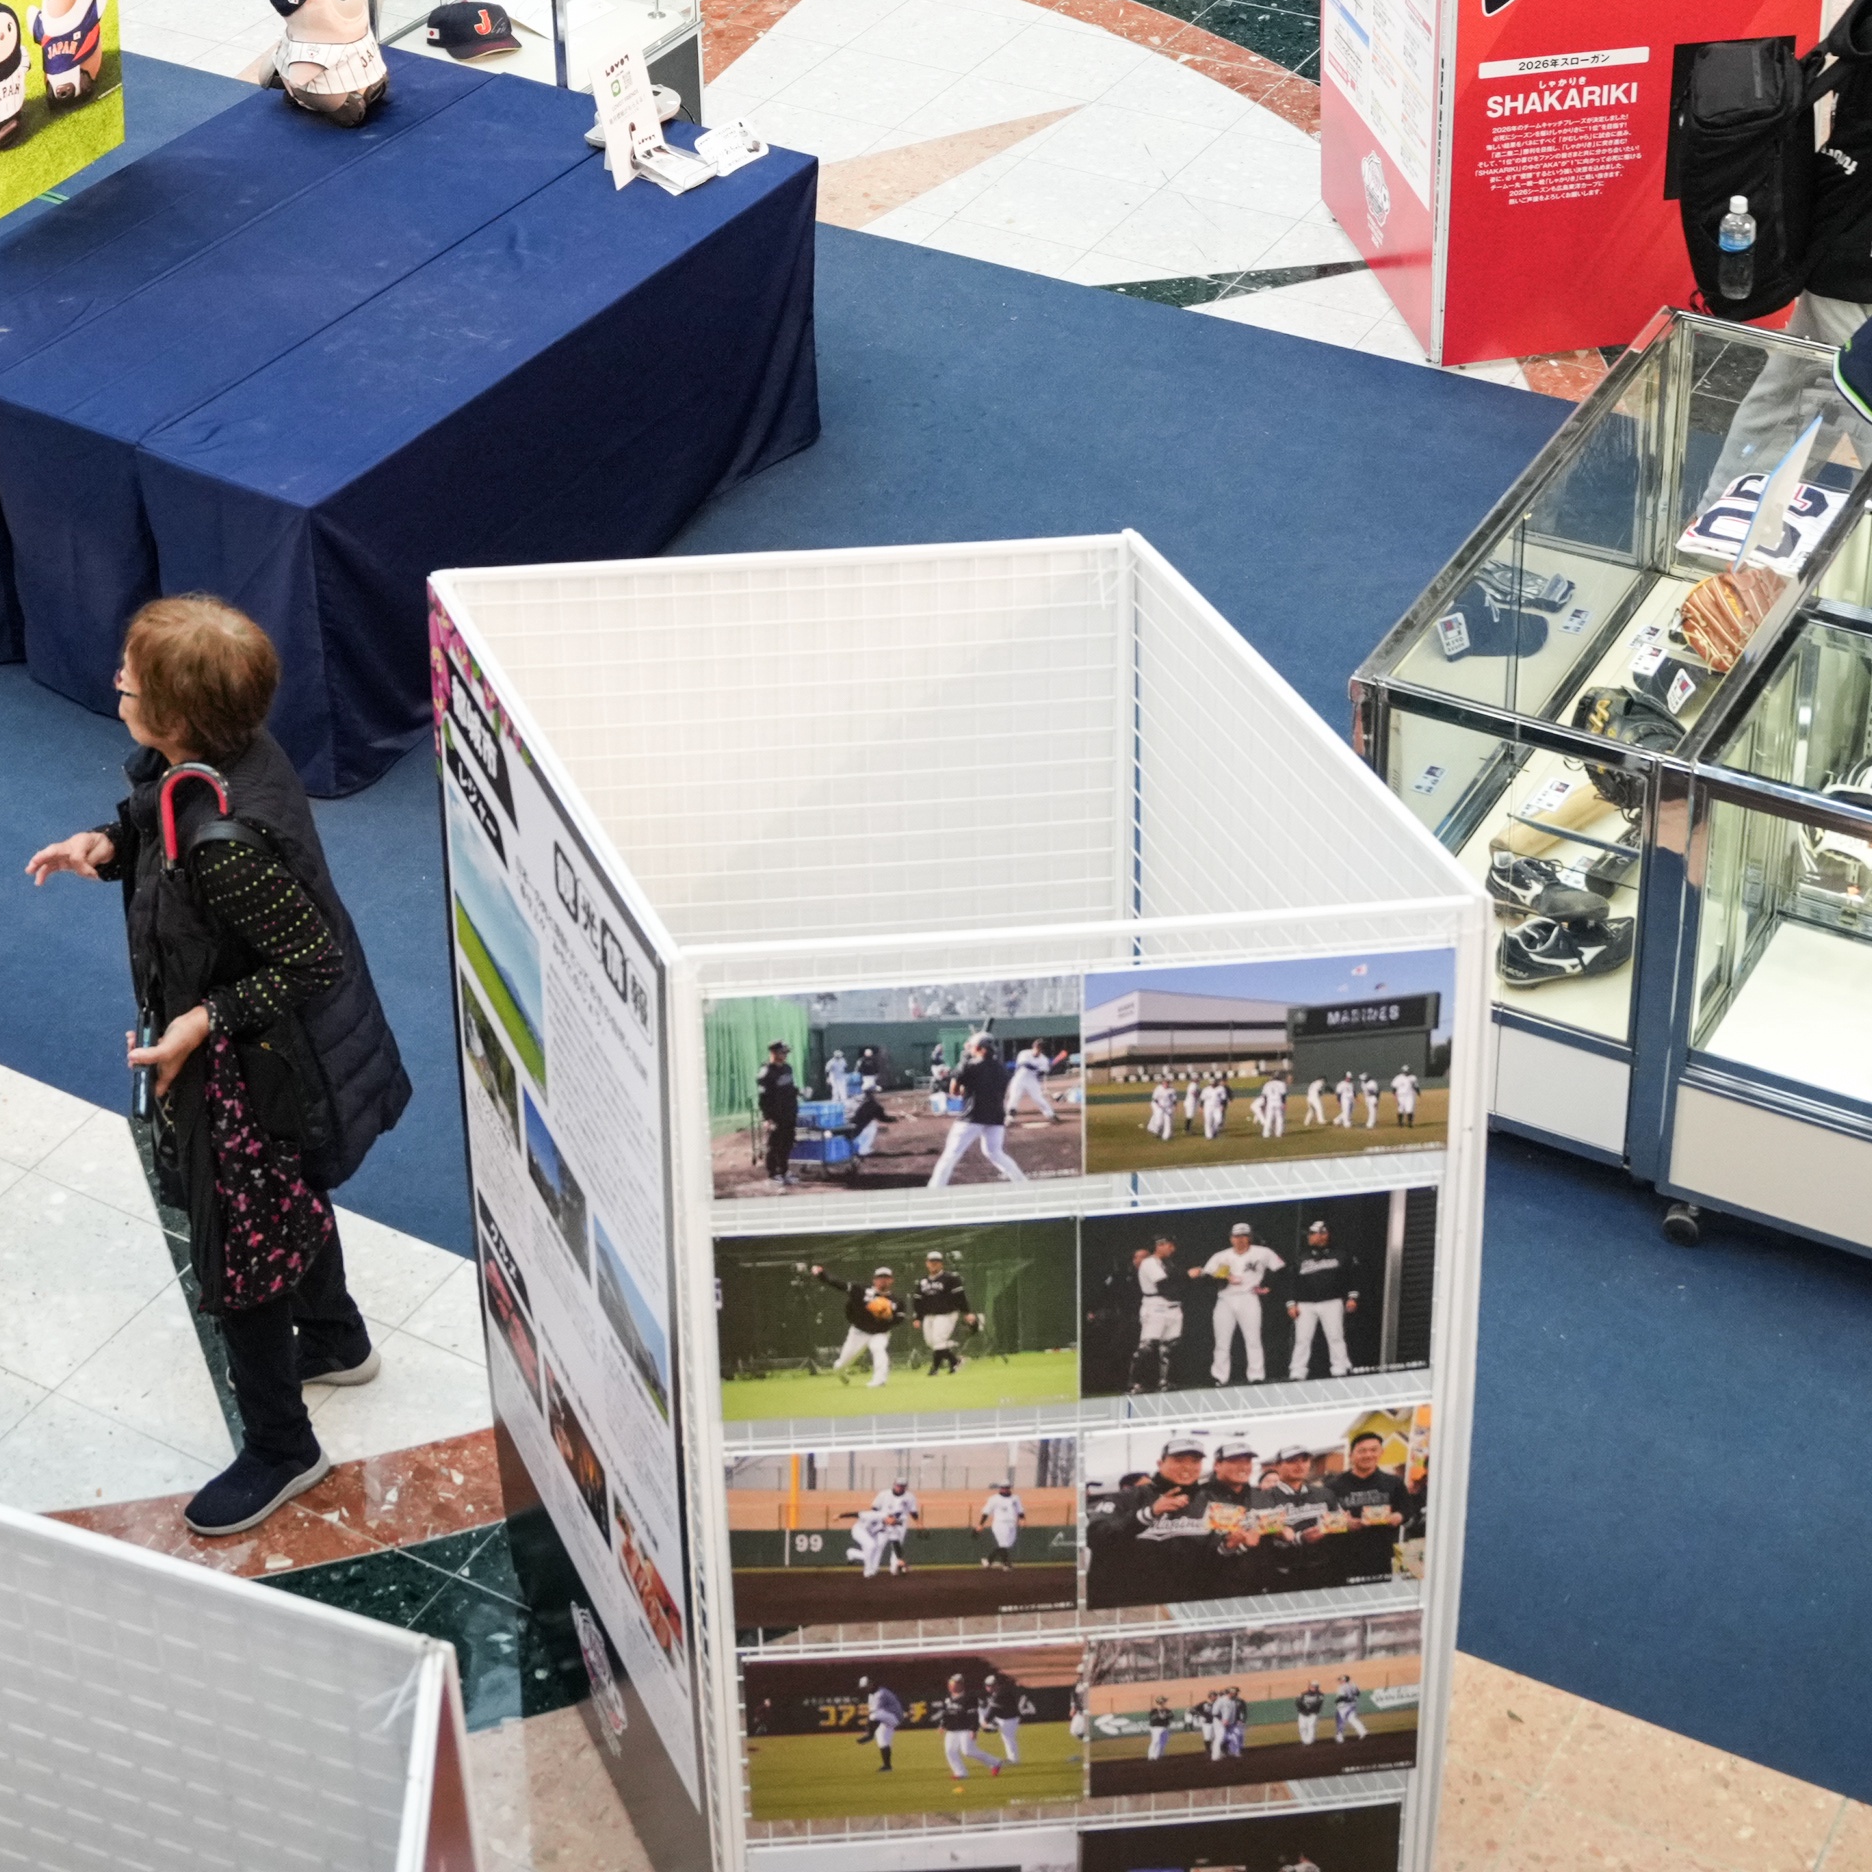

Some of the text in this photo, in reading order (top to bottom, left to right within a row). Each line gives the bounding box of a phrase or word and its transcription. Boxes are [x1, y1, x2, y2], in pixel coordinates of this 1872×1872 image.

[473, 8, 492, 35] J
[47, 37, 78, 62] JAPAN
[1517, 53, 1611, 72] 2026年スローガン
[1538, 75, 1587, 89] しゃかりき
[1486, 81, 1638, 118] SHAKARIKI
[794, 1533, 823, 1553] 99
